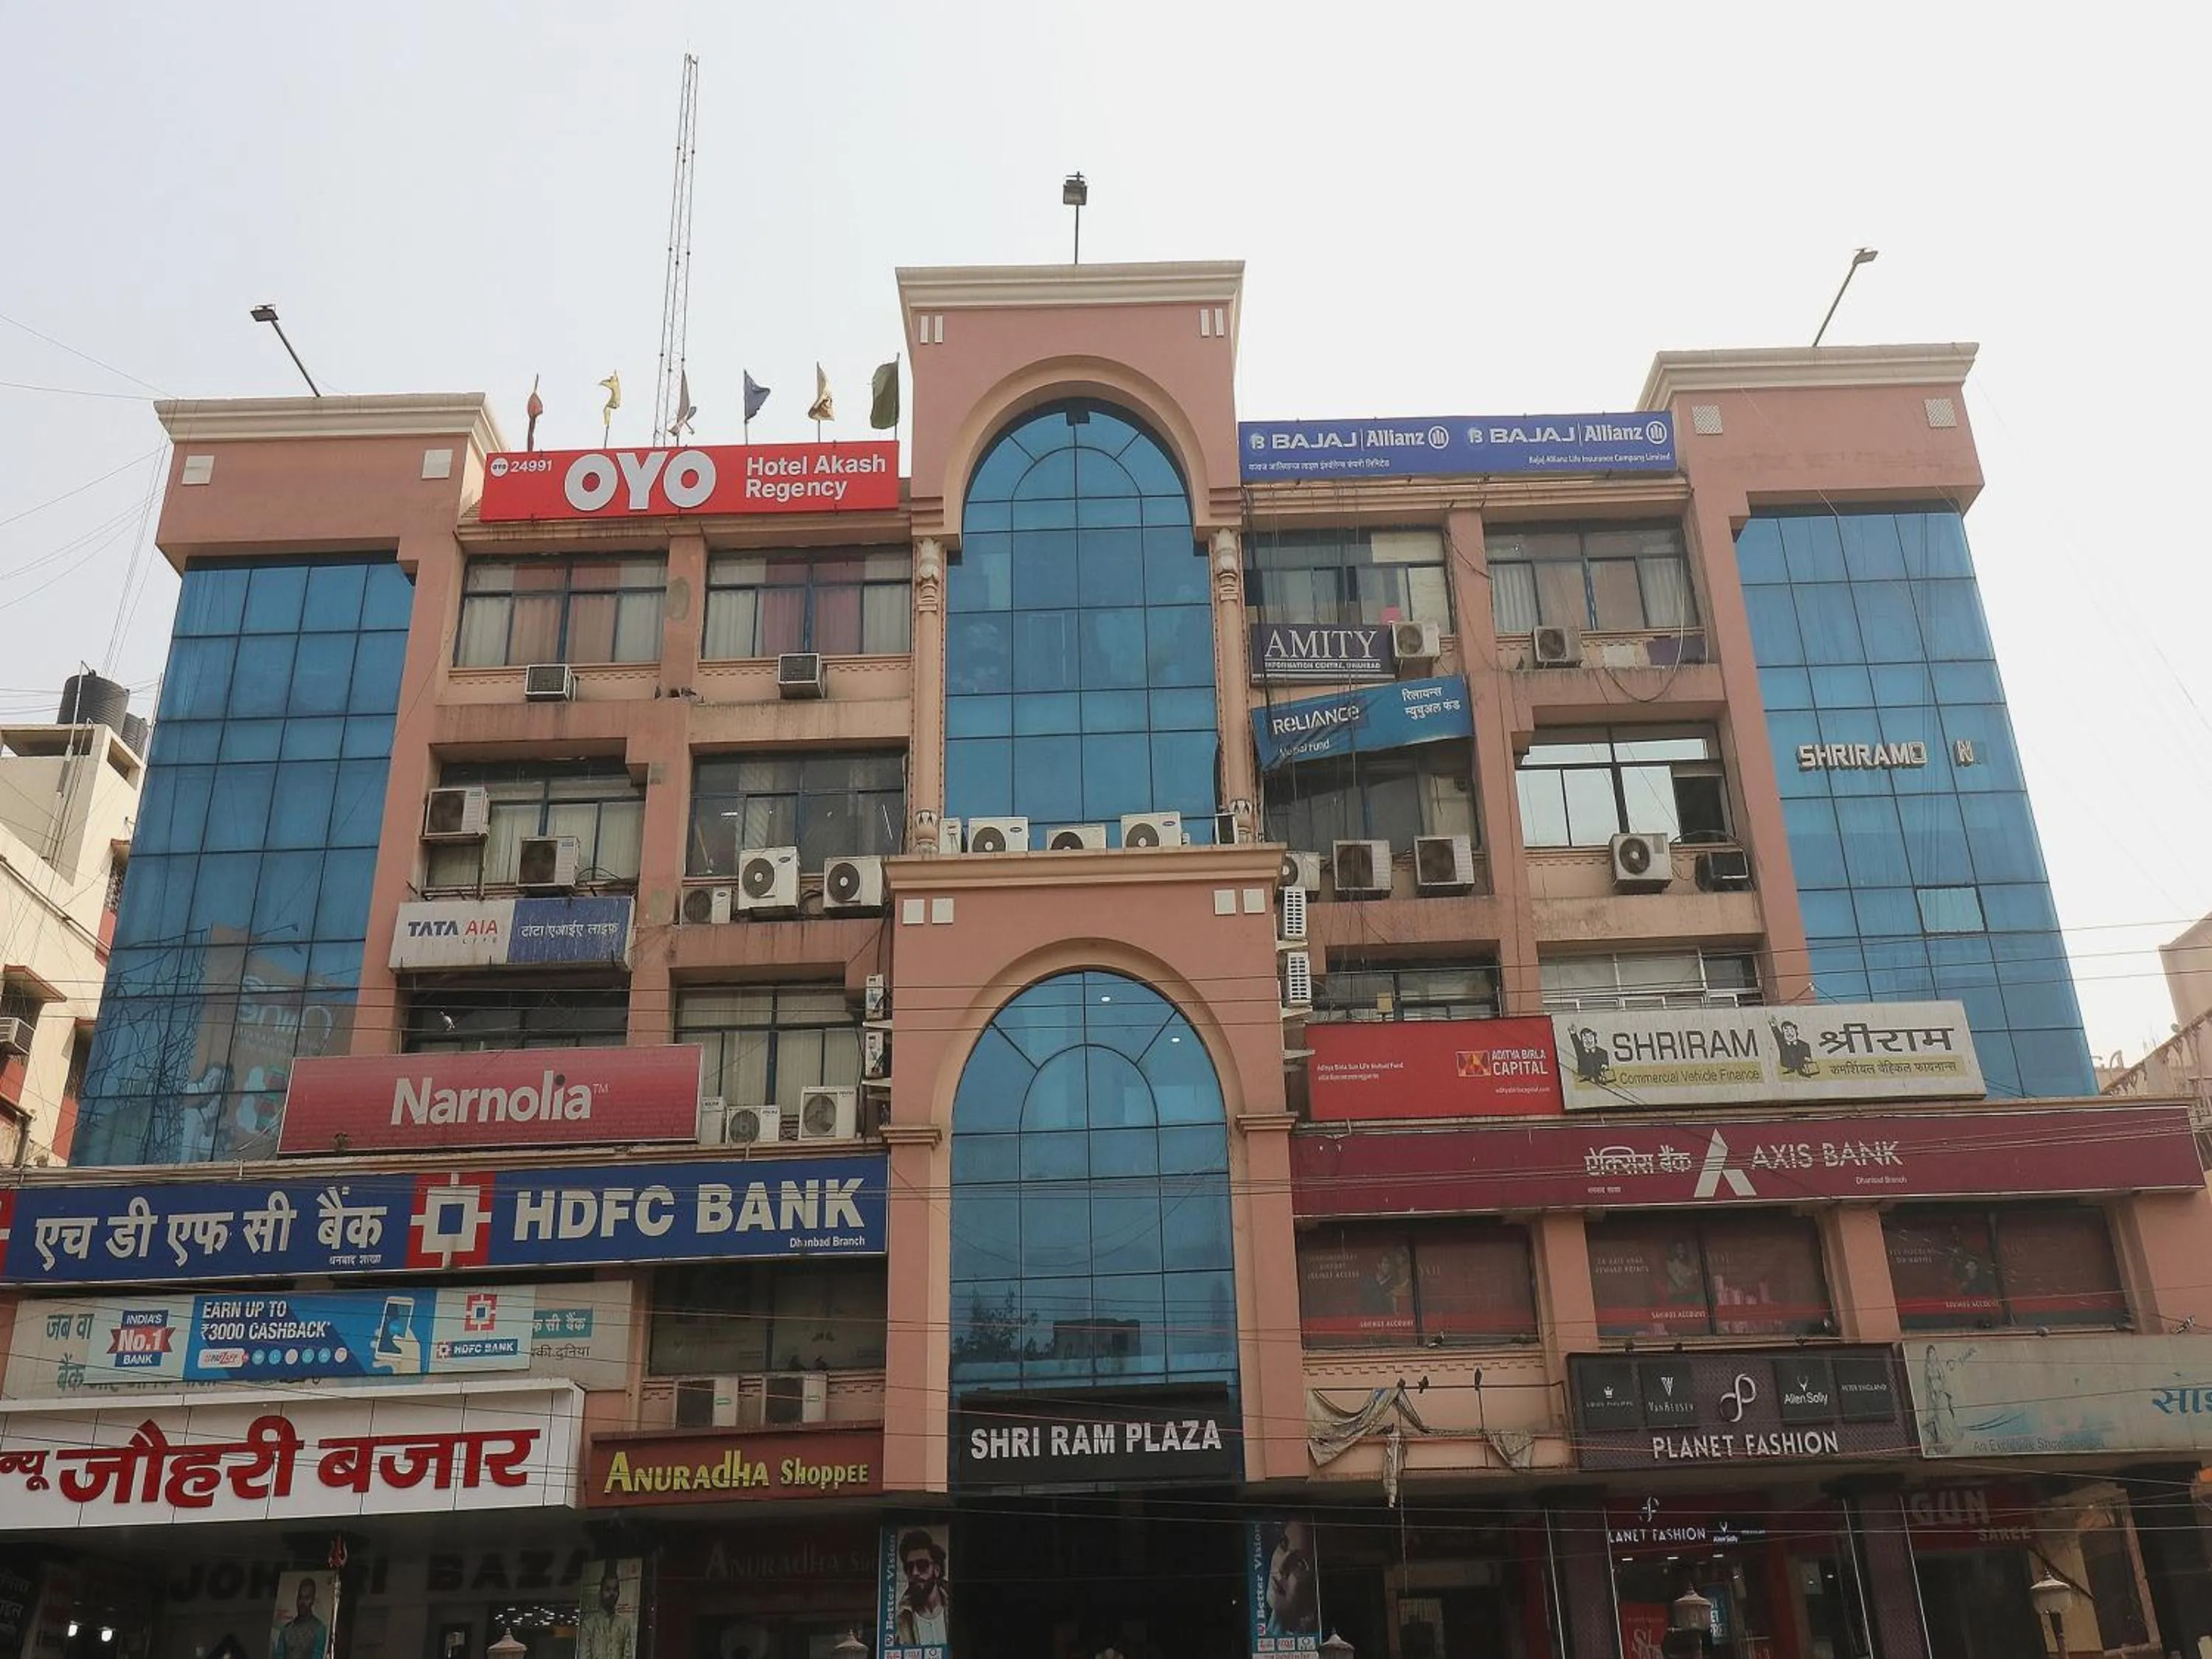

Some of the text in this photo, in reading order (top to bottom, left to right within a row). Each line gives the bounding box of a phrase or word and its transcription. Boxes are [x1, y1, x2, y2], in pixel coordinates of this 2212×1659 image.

[1272, 432, 1357, 449] BAJAJ
[1366, 430, 1425, 447] Allianz
[1490, 427, 1575, 443] BAJAJ
[1585, 424, 1643, 442] Allianz
[510, 459, 553, 473] 24991
[746, 453, 886, 478] Hotel Akash
[1615, 454, 1645, 463] Company
[564, 450, 716, 512] OYO
[745, 477, 847, 502] Regency
[1265, 629, 1377, 658] AMITY
[408, 919, 498, 937] TATA AIA
[521, 925, 545, 937] टाटा
[1613, 1029, 1759, 1062] SHRIRAM
[1819, 1023, 1955, 1054] श्रीराम
[1492, 1049, 1546, 1061] ADITYA BIRLA
[1493, 1060, 1549, 1076] CAPITAL
[1619, 1068, 1760, 1085] Commercial Vehicle Finance
[391, 1070, 593, 1126] Narnolia
[1657, 1144, 1692, 1173] बैंक
[1751, 1141, 1903, 1169] AXIS BANK
[513, 1178, 867, 1241] HDFC BANK
[35, 1186, 387, 1272] एच डी एफ सी बैंक
[790, 1234, 866, 1249] Dhanbad Branch
[203, 1300, 287, 1318] EARN UP TO
[125, 1314, 162, 1325] INDIA'S
[565, 1311, 586, 1332] बैंक
[118, 1327, 162, 1352] No.1
[201, 1322, 244, 1341] ₹3000
[454, 1342, 514, 1354] HDFC BANK
[123, 1354, 153, 1365] BANK
[970, 1419, 1222, 1460] SHRI RAM PLAZA
[1652, 1430, 1839, 1459] PLANET FASHION
[55, 1415, 305, 1508] जौहरी
[317, 1428, 540, 1494] बजार
[1607, 1527, 1706, 1543] LANET FASHION
